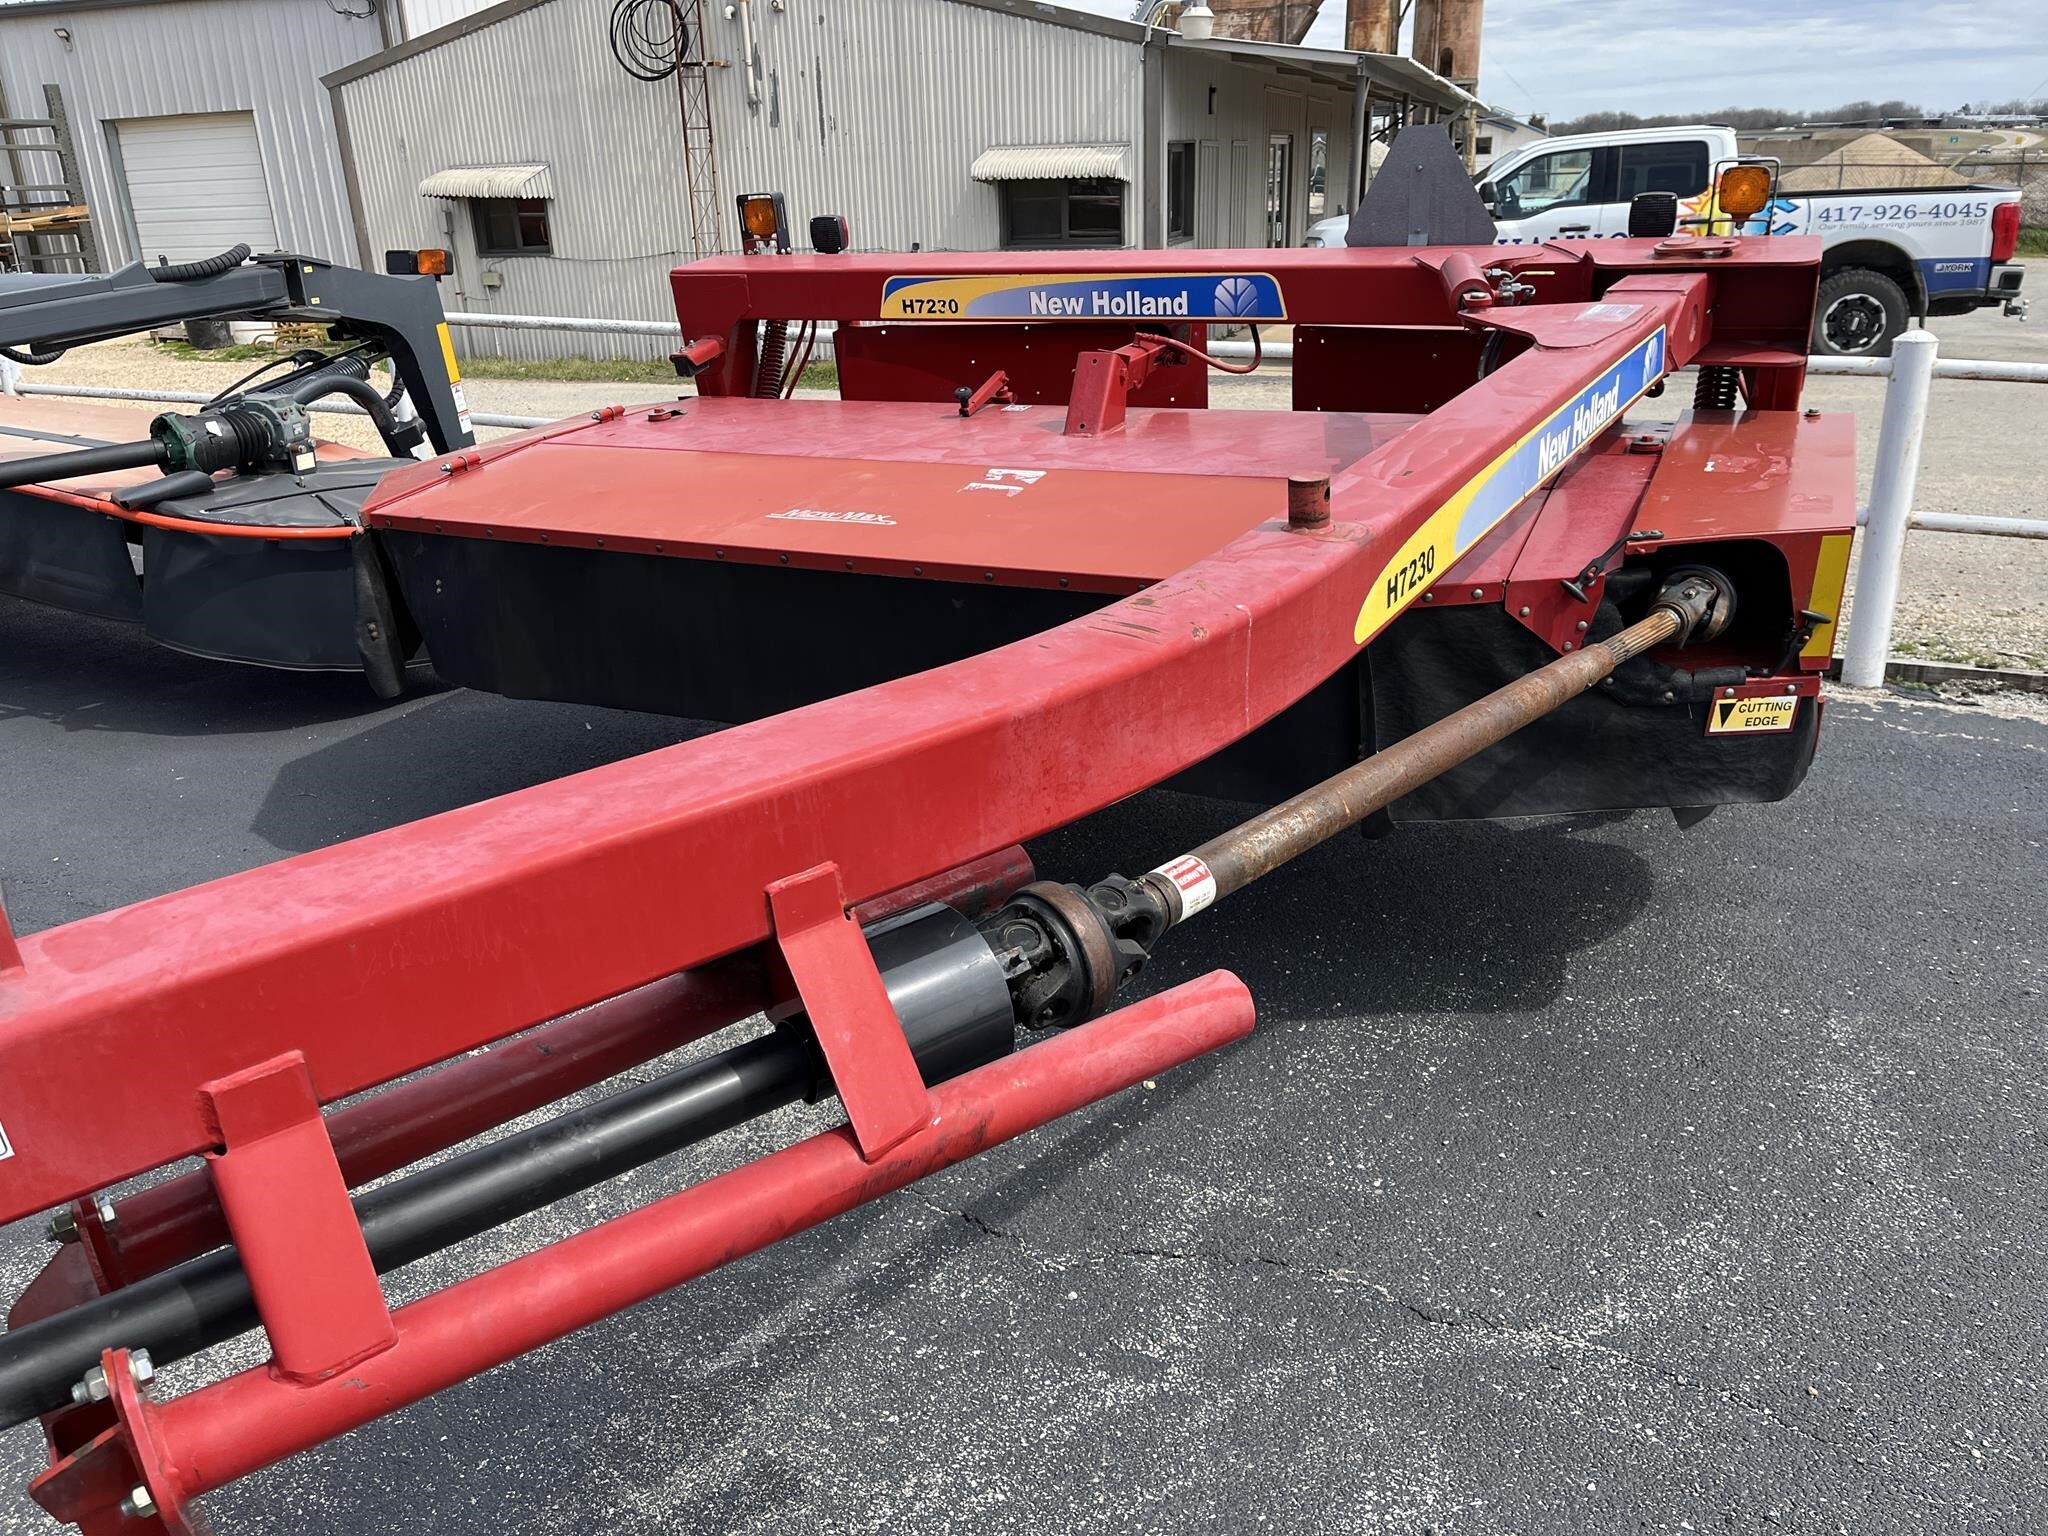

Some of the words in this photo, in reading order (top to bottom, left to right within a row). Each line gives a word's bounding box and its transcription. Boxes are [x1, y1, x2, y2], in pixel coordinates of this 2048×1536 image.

[1818, 203, 1989, 222] 417-926-4045
[1818, 222, 1837, 231] Our
[1839, 221, 1869, 231] family
[1870, 220, 1905, 230] serving
[1907, 220, 1932, 231] yours
[1945, 263, 1971, 272] YORK
[901, 298, 959, 314] H7230
[1029, 291, 1085, 315] New
[1092, 290, 1189, 315] Holland
[1537, 425, 1571, 480] New
[1572, 375, 1619, 441] Holland
[1386, 545, 1436, 608] H7230
[1738, 702, 1792, 713] CUTTING
[1745, 716, 1779, 727] EDGE
